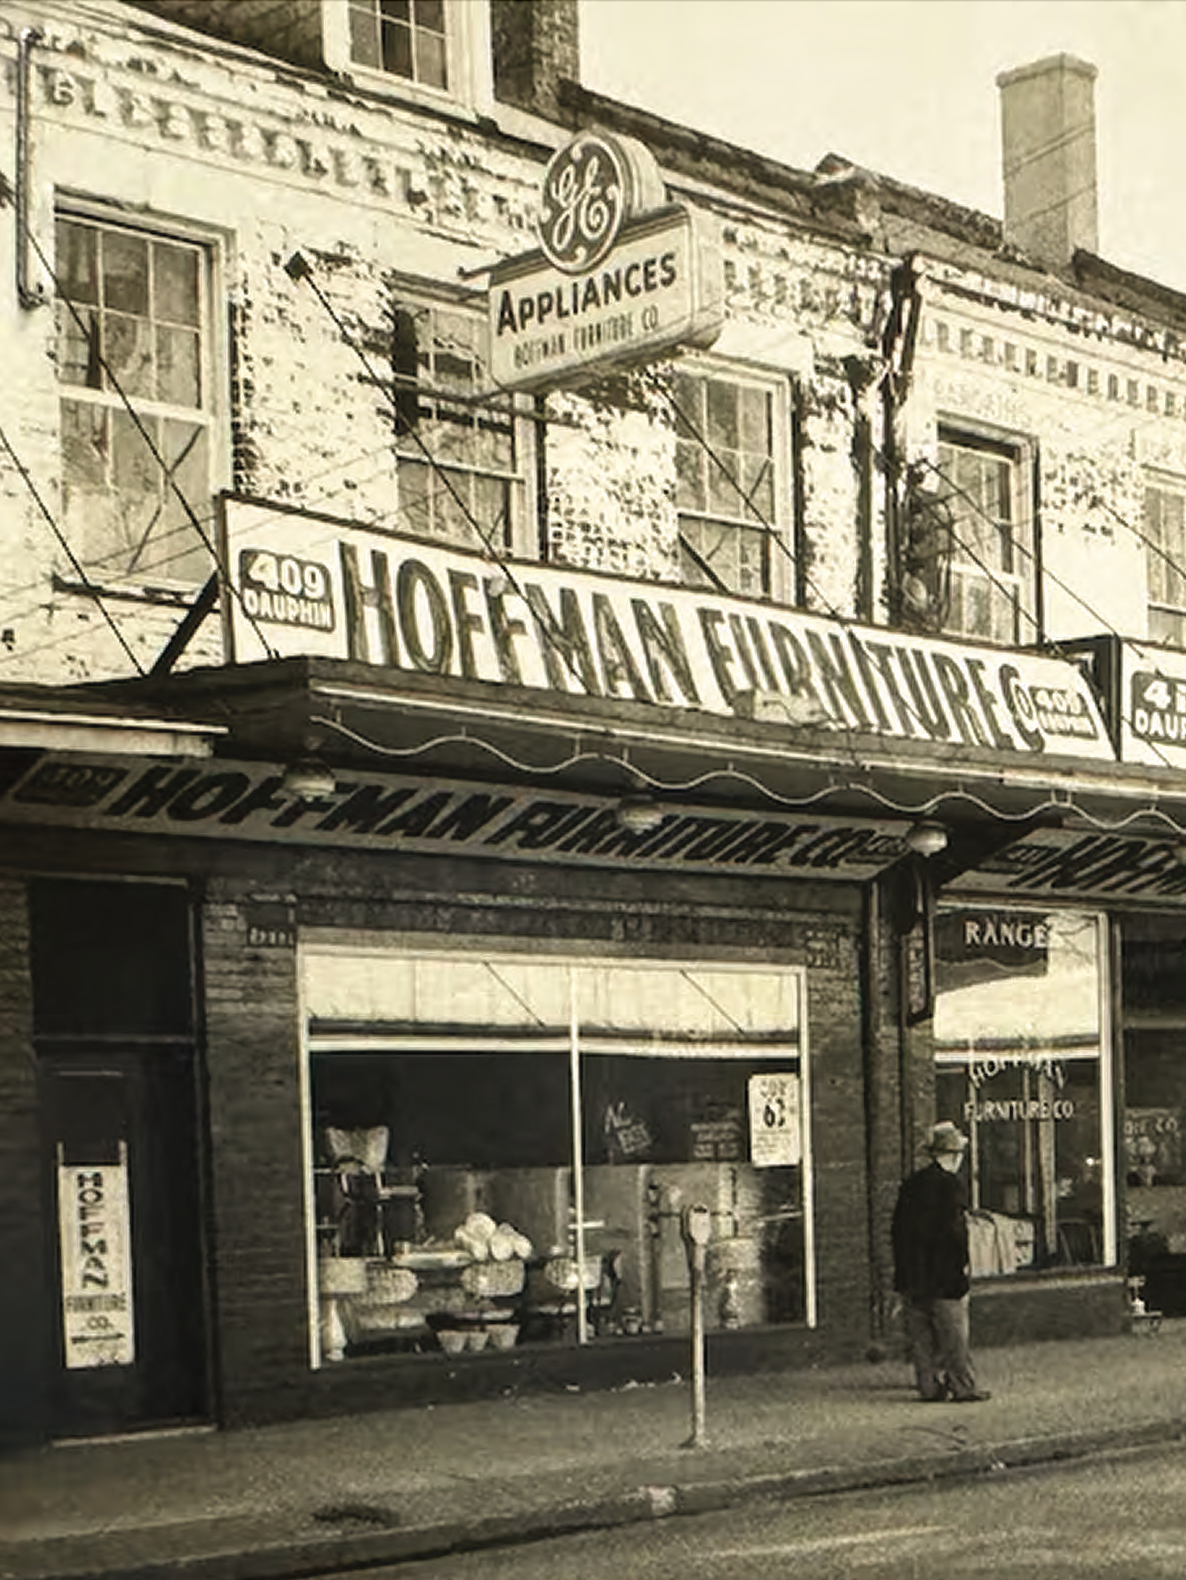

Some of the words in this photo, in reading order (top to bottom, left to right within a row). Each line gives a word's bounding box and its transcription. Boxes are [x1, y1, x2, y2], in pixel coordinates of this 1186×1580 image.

[246, 553, 326, 601] 409
[244, 588, 332, 630] DAUPHIN
[339, 540, 701, 711] HOFFMAN
[697, 607, 1016, 750] FURNITURE
[104, 765, 511, 841] HOFFMAN
